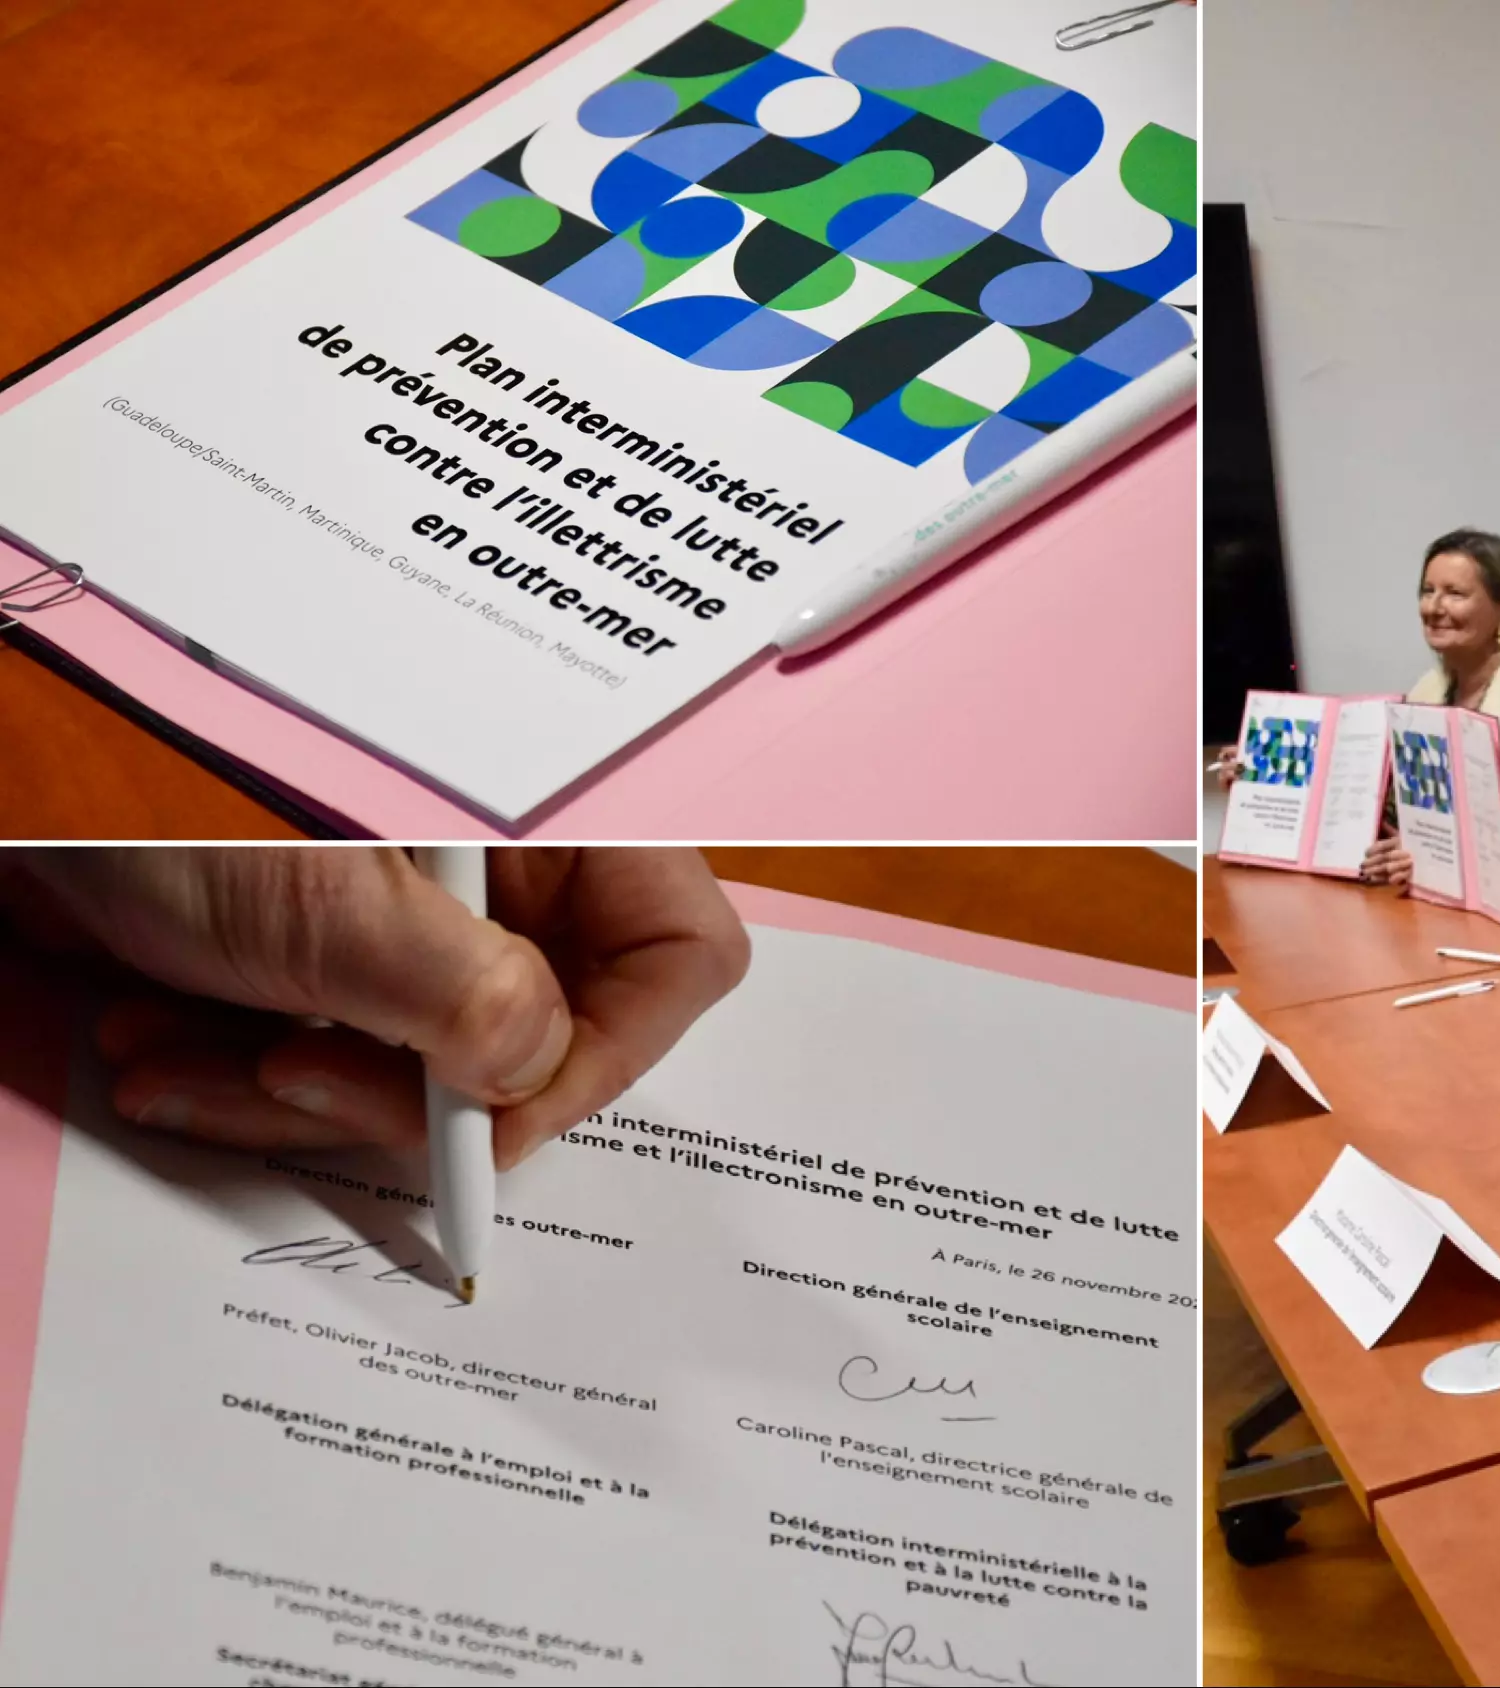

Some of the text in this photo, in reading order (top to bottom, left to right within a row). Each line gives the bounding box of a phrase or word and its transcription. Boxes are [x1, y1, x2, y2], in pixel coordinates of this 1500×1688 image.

[298, 322, 780, 583] de prévention et de lutte
[436, 333, 844, 547] Plan interministériel
[102, 396, 296, 511] (Guadeloupe/Saint-Martin,
[298, 505, 385, 562] Martinique,
[388, 555, 451, 598] Guyane,
[454, 591, 476, 609] La
[476, 602, 544, 649] Réunion,
[364, 422, 727, 623] contre l'illettrisme
[410, 509, 677, 659] en outre-mer
[264, 1157, 370, 1193] Direction
[492, 1211, 515, 1227] es
[522, 1219, 634, 1250] outre-mer
[613, 1112, 822, 1171] interministériel
[831, 1160, 866, 1180] de
[875, 1169, 1025, 1212] prévention
[1033, 1201, 1061, 1220] et
[1070, 1209, 1105, 1228] de
[1114, 1216, 1180, 1242] lutte
[633, 1144, 1053, 1240] et l'illectronisme en outre-mer
[743, 1260, 846, 1291] Direction
[852, 1283, 948, 1311] générale
[954, 1301, 983, 1318] de
[931, 1248, 947, 1262] À
[952, 1253, 1001, 1276] Paris,
[1008, 1264, 1026, 1278] le
[1031, 1269, 1056, 1283] 26
[1061, 1278, 1162, 1303] novembre
[222, 1303, 657, 1412] Préfet, Olivier Jacob, directeur général
[907, 1311, 993, 1337] scolaire
[359, 1354, 519, 1402] des outre-mer
[221, 1393, 348, 1434] Délégation
[355, 1425, 454, 1458] générale
[460, 1446, 473, 1463] à
[581, 1474, 603, 1491] et
[610, 1476, 622, 1494] à
[630, 1483, 650, 1499] la
[284, 1426, 586, 1506] formation professionnelle
[737, 1417, 1173, 1507] Caroline Pascal, directrice générale de
[1001, 1481, 1090, 1509] scolaire
[769, 1510, 1147, 1591] Délégation interministérielle à la
[769, 1533, 1148, 1611] prévention et à la lutte contre la
[906, 1579, 1010, 1609] pauvreté
